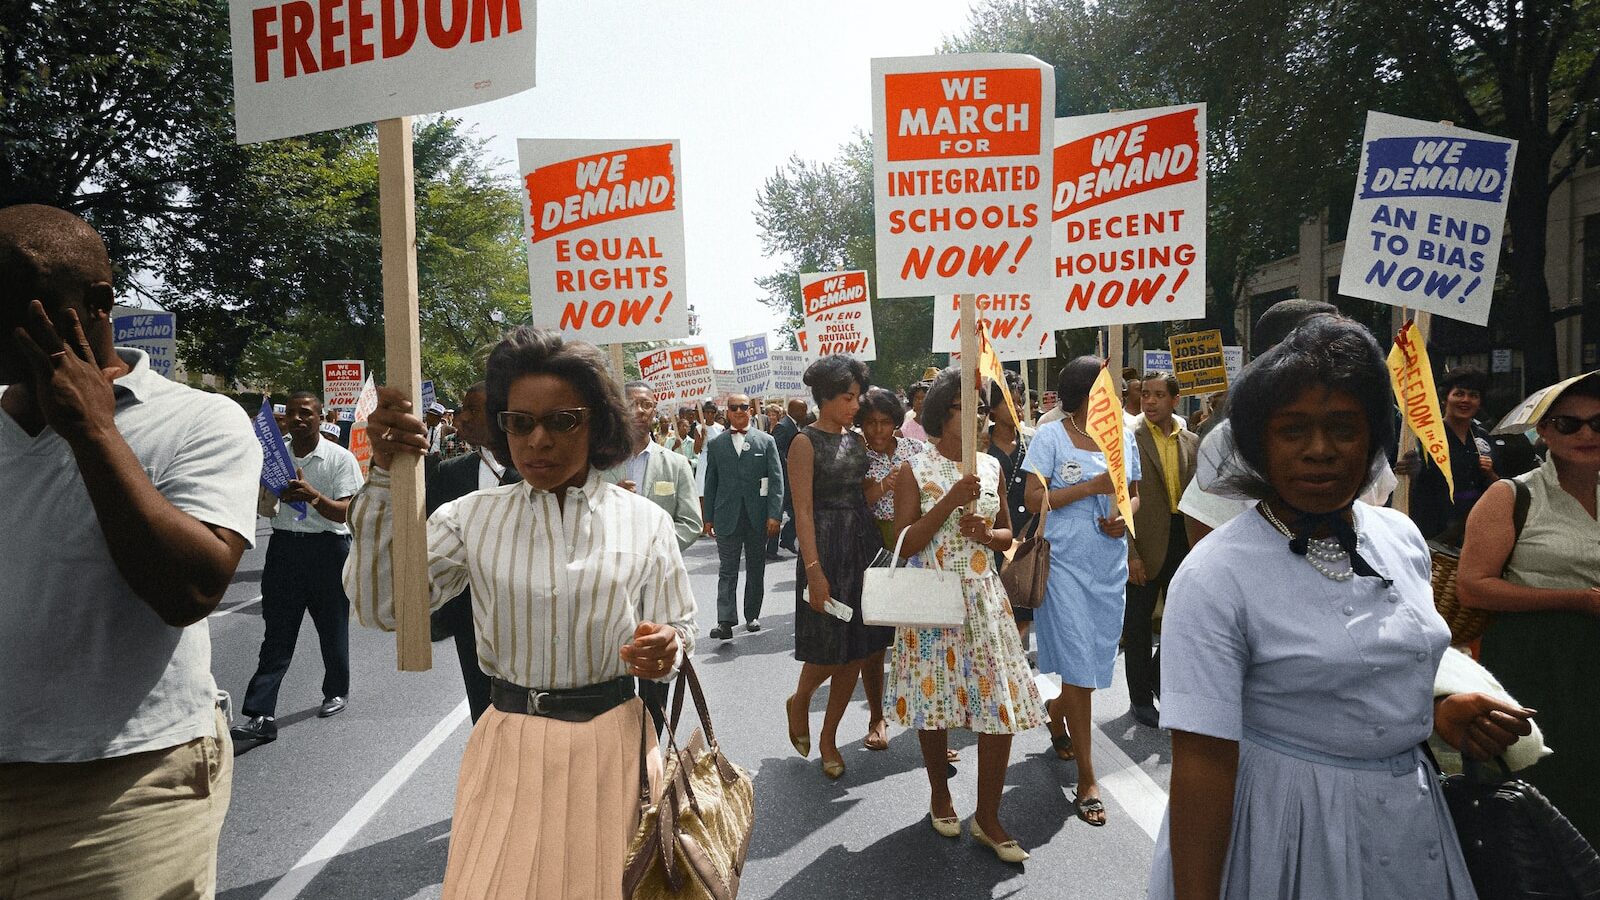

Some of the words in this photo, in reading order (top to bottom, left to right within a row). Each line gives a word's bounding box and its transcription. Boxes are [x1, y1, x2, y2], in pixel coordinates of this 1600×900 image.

[252, 0, 522, 83] FREEDOM
[941, 77, 986, 100] WE
[898, 104, 1029, 136] MARCH
[940, 139, 990, 154] FOR
[1091, 125, 1148, 166] WE
[1412, 140, 1466, 165] WE
[576, 154, 628, 190] WE
[888, 165, 1040, 197] INTEGRATED
[1053, 144, 1193, 212] DEMAND
[1371, 167, 1501, 194] DEMAND
[541, 175, 670, 231] DEMAND
[889, 204, 1038, 234] SCHOOLS
[1067, 210, 1184, 243] DECENT
[1370, 204, 1417, 230] AN
[1427, 214, 1491, 245] END
[556, 237, 663, 262] EQUAL
[901, 235, 1032, 280] NOW!
[1056, 244, 1196, 278] HOUSING
[1371, 231, 1408, 256] TO
[1417, 240, 1485, 272] BIAS
[556, 266, 668, 292] RIGHTS
[823, 276, 847, 293] WE
[1065, 268, 1189, 312] NOW!
[1365, 259, 1481, 304] NOW!
[809, 285, 864, 312] DEMAND
[952, 294, 1031, 311] RGHTS
[132, 316, 154, 327] WE
[560, 291, 673, 331] NOW!
[815, 313, 833, 322] AN
[837, 311, 862, 320] END
[118, 325, 170, 340] DEMAND
[818, 332, 861, 342] BRUTALITY
[826, 323, 855, 333] POLICE
[950, 314, 1033, 340] NW!
[650, 351, 665, 364] WE
[737, 346, 765, 359] MARCH
[818, 337, 869, 356] NOW!
[1174, 344, 1206, 359] JOBS
[674, 354, 704, 365] MARCH
[736, 366, 753, 375] FIRST
[753, 362, 769, 372] CLASS
[1175, 356, 1222, 373] FREEDOM
[673, 367, 710, 379] INTEGRATED
[675, 376, 712, 388] SCHOOLS
[737, 369, 771, 384] CITIZENSHIP
[681, 384, 712, 398] NOW!
[744, 380, 770, 395] NOW!
[774, 381, 801, 390] REEDOM
[329, 396, 360, 406] NOW!
[256, 411, 275, 445] MARCH
[272, 449, 291, 480] WASHINGT
[1425, 429, 1435, 441] IN
